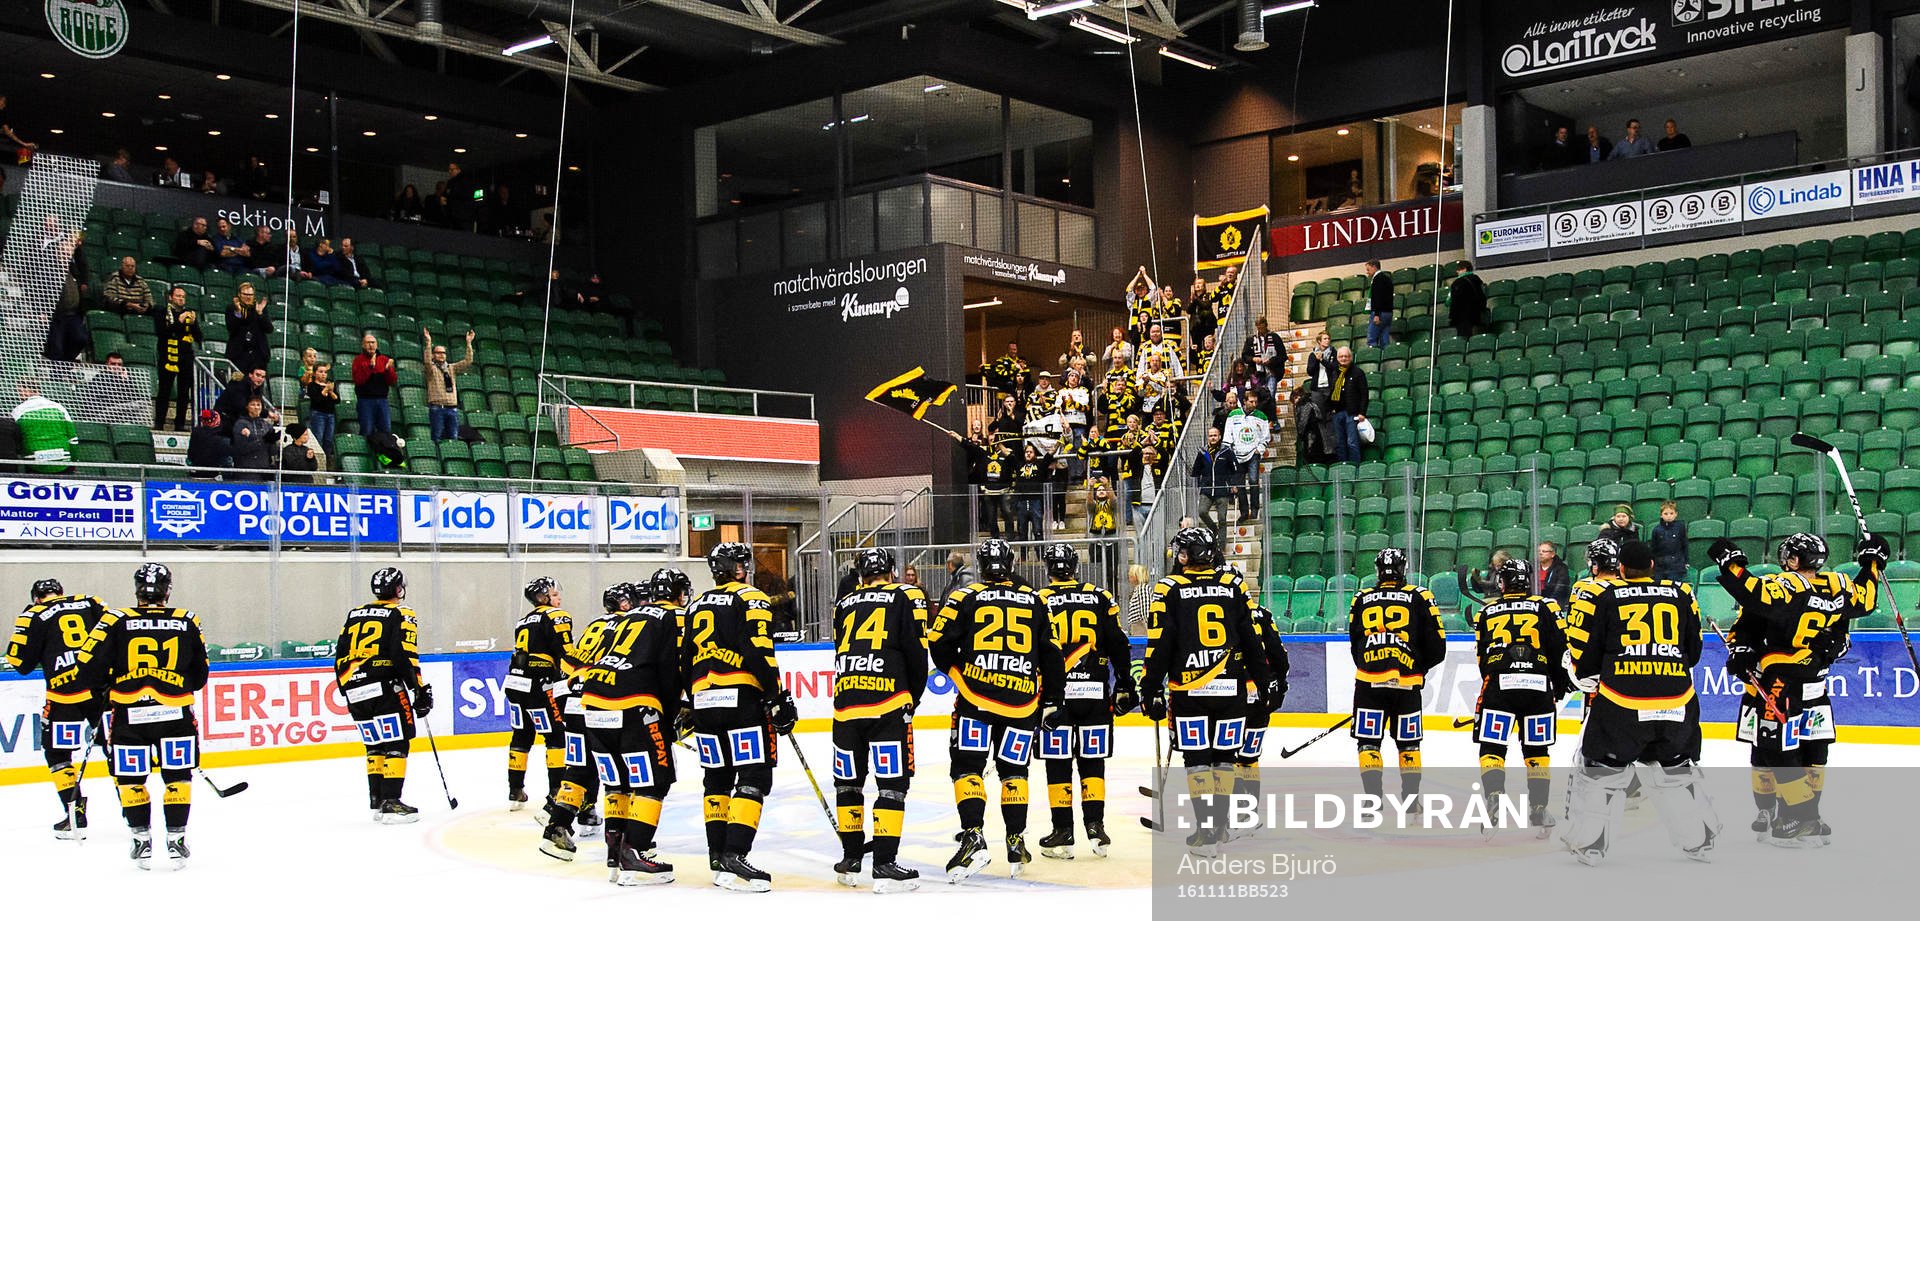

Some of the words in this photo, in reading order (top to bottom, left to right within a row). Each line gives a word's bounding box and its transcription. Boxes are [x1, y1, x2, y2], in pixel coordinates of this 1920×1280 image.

[1523, 22, 1548, 38] Allt
[1549, 19, 1581, 32] inom
[1583, 7, 1635, 25] etiketter
[1687, 21, 1754, 43] Innovative
[1760, 8, 1821, 29] recycling
[1533, 17, 1657, 67] LariTryck
[1859, 164, 1903, 191] HNA
[1779, 182, 1842, 205] Lindab
[217, 204, 296, 231] sektion
[305, 215, 325, 237] M
[1303, 207, 1441, 251] LINDAHL
[1493, 224, 1541, 238] EUROMASTER
[773, 257, 927, 296] matchvärdsloungen
[91, 484, 134, 501] AB
[209, 489, 393, 515] CONTAINER
[0, 509, 39, 518] Mattor
[58, 510, 100, 519] Parkett
[239, 513, 369, 537] POOLEN
[610, 500, 679, 531] Diab
[20, 523, 134, 539] ÄNGELHOLM
[1182, 586, 1234, 599] BOLIDEN
[1365, 592, 1412, 603] BOLIDEN
[1618, 586, 1678, 598] BOLIDEN
[1362, 605, 1410, 643] 92
[1489, 602, 1539, 615] BOLIDEN
[1567, 609, 1584, 627] 30
[58, 614, 89, 649] 8
[347, 620, 383, 656] 12
[757, 621, 768, 636] 2
[837, 607, 889, 654] 14
[973, 605, 1033, 654] 25
[1052, 609, 1098, 650] 16
[1197, 604, 1227, 647] 6
[1487, 614, 1541, 649] 33
[1618, 603, 1679, 646] 30
[128, 636, 179, 671] 61
[974, 653, 1033, 675] AllTele
[1614, 661, 1687, 676] LINDVALL
[1857, 666, 1883, 697] T.
[250, 719, 327, 747] BYGG
[648, 722, 669, 767] REPAY
